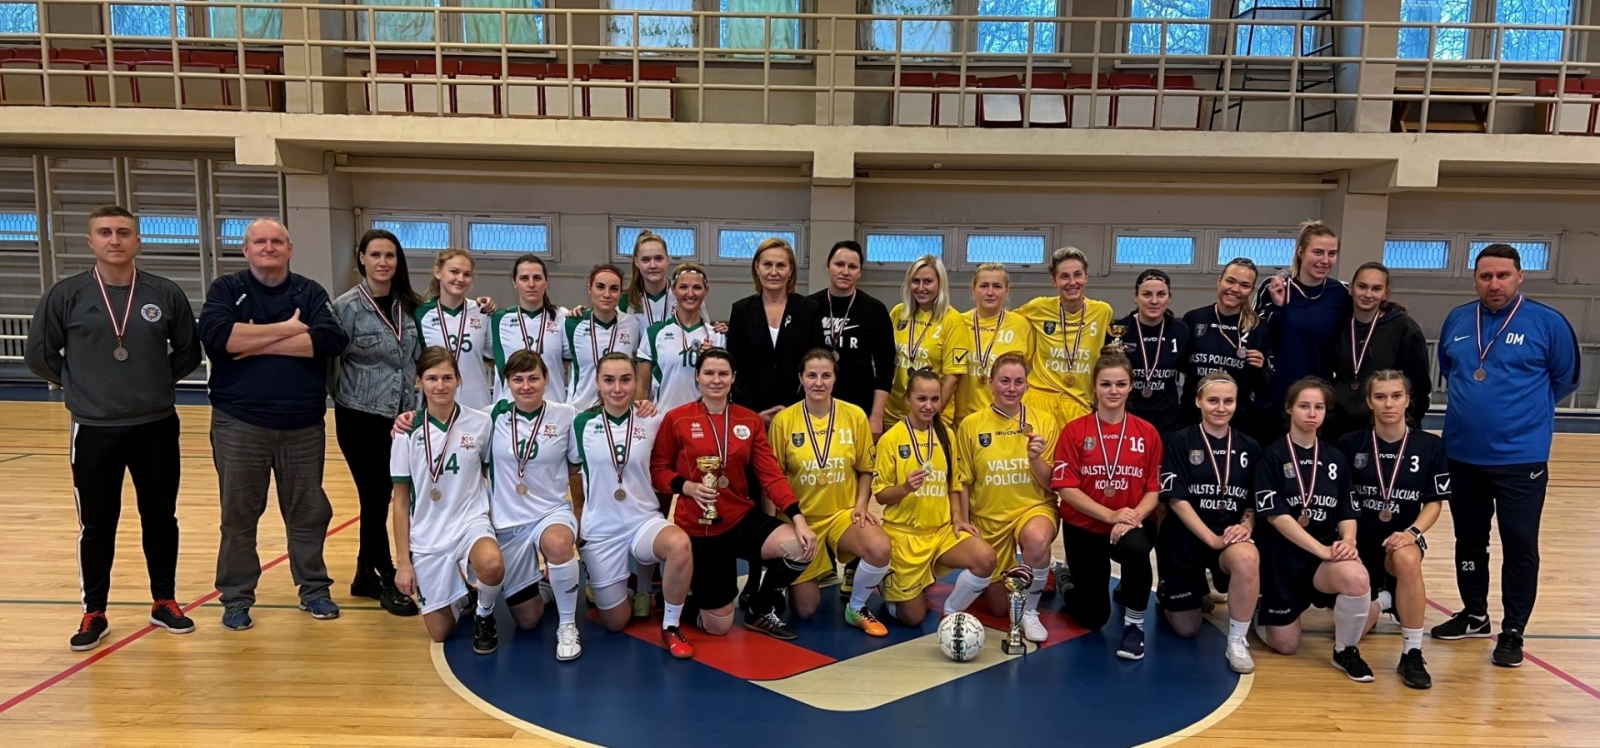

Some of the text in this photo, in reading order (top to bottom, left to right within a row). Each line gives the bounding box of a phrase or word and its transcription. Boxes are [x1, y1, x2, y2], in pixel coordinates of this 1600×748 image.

[932, 325, 942, 339] 2
[997, 330, 1014, 344] 10
[1090, 322, 1097, 337] 5
[448, 334, 473, 353] 35
[1171, 338, 1178, 353] 1
[1505, 332, 1525, 346] DM
[838, 428, 853, 444] 11
[1130, 436, 1145, 453] 16
[987, 458, 1030, 471] VALSTS
[1240, 451, 1248, 468] 6
[1409, 455, 1420, 472] 3
[1328, 463, 1338, 480] 8
[985, 473, 1032, 486] POLICIJA
[1462, 560, 1475, 572] 23
